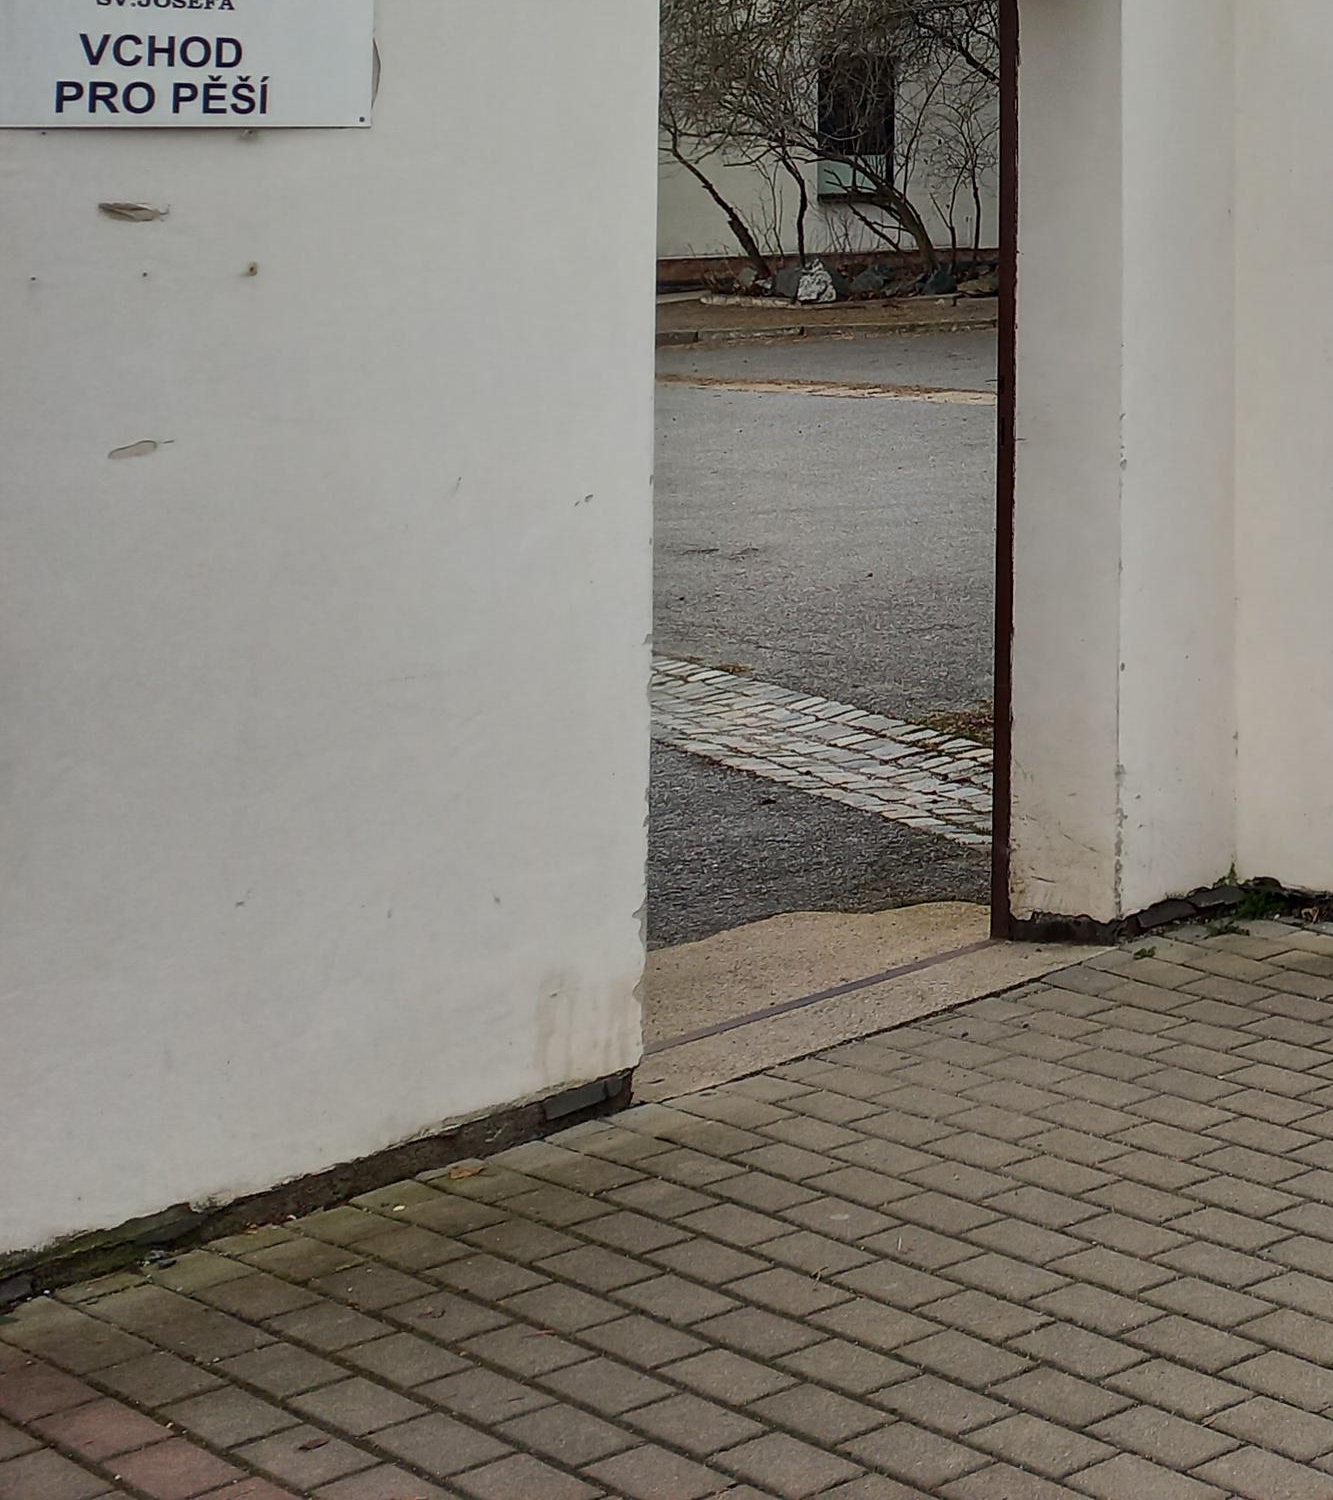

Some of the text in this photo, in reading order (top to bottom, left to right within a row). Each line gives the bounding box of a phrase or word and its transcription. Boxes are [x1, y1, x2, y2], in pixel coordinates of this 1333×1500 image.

[79, 33, 243, 68] VCHOD
[55, 75, 270, 114] PRO PĚŠÍ
